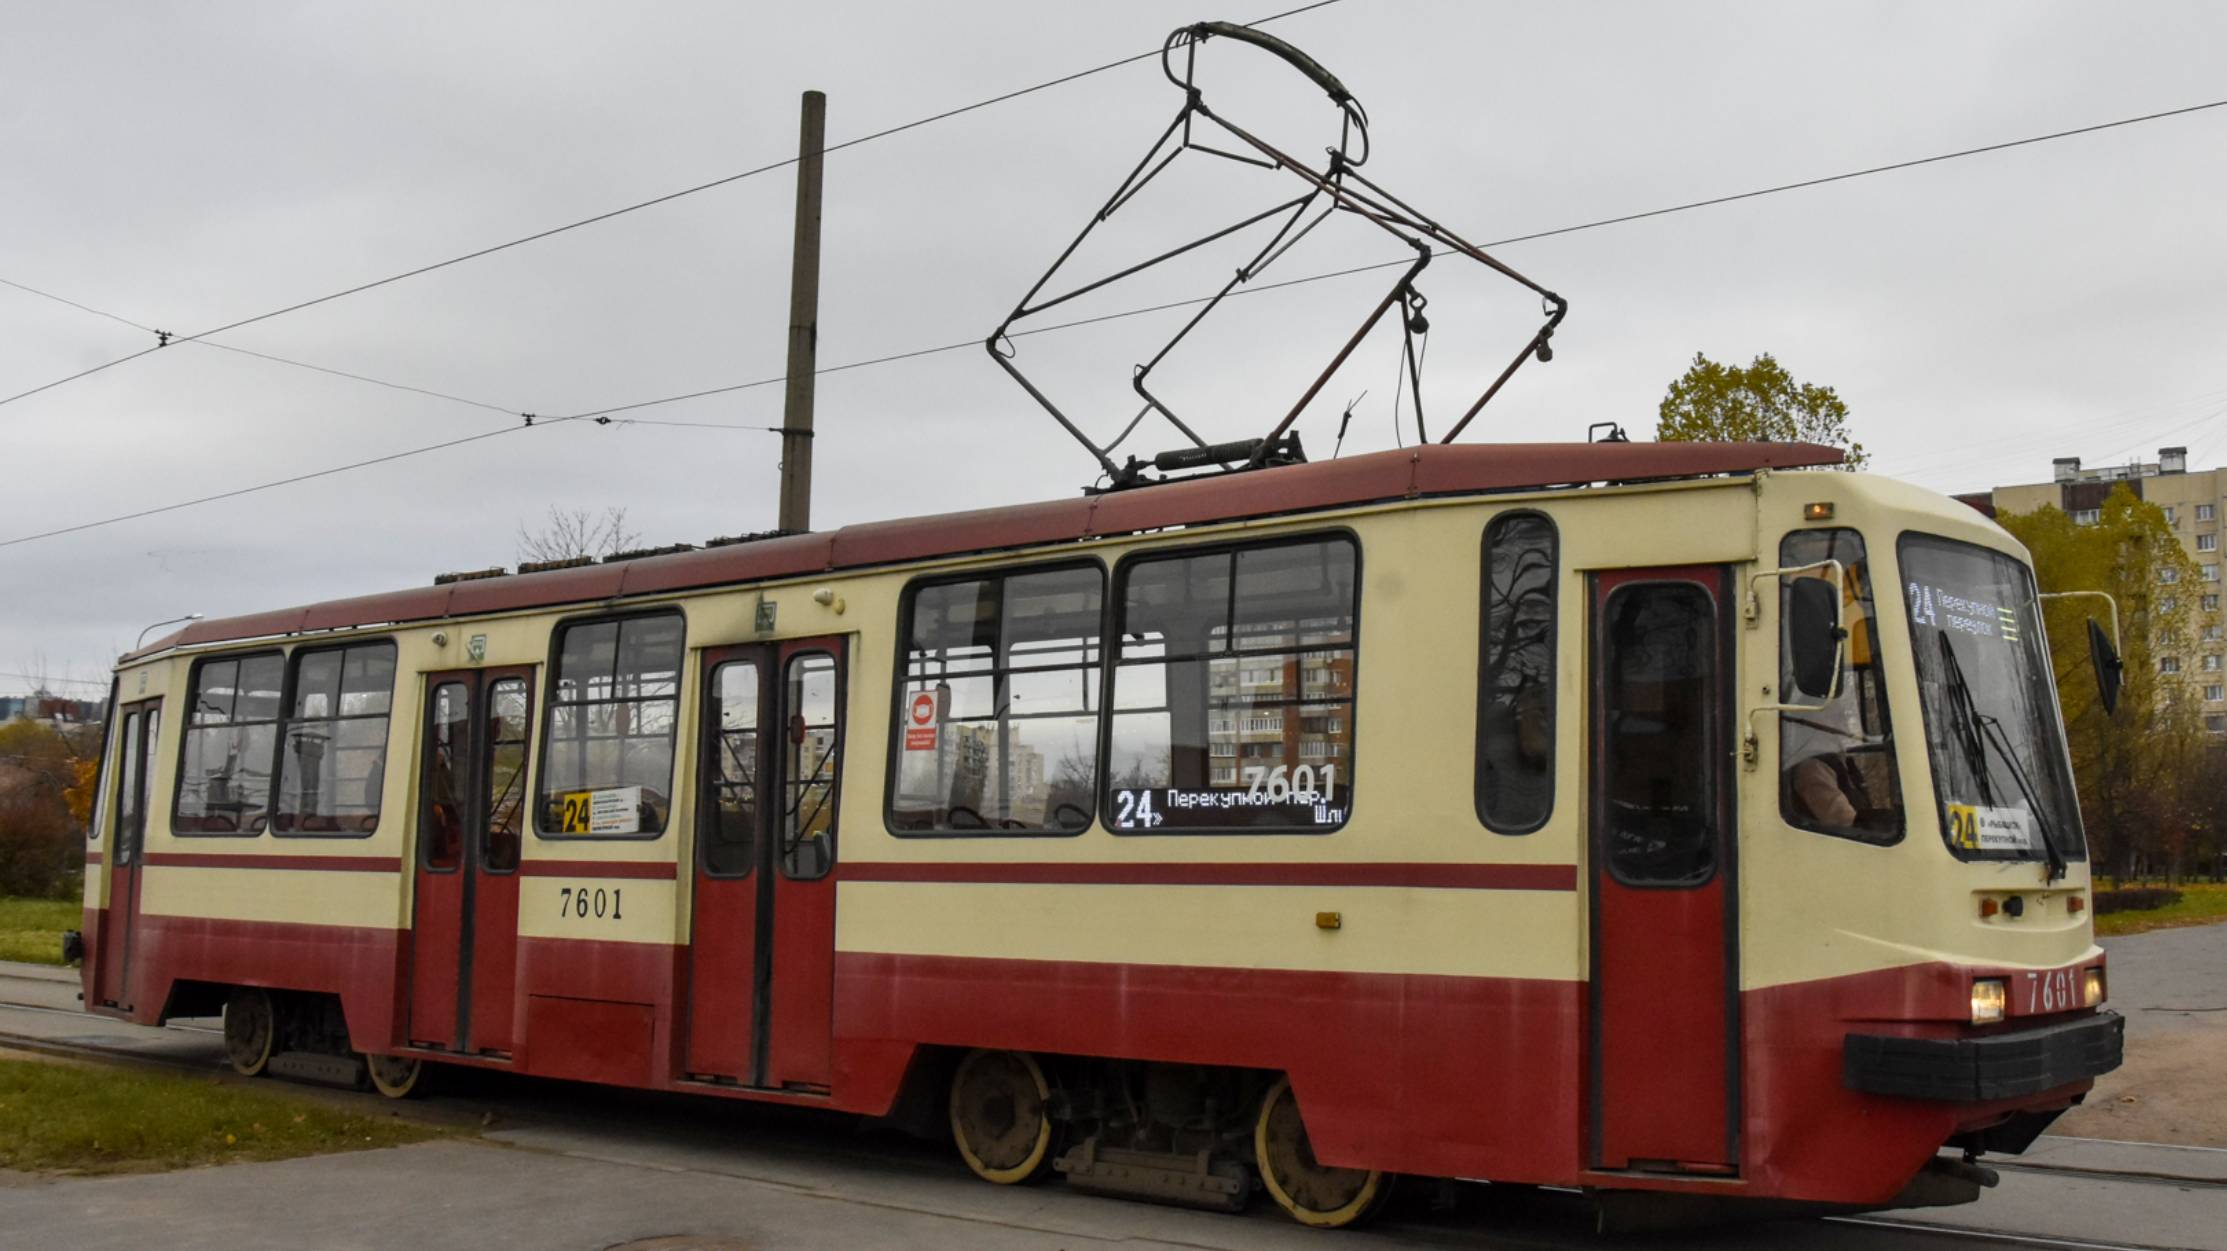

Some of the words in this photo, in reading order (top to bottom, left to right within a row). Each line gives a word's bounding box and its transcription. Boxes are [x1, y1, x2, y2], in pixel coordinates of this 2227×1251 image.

[1909, 582, 1936, 626] 24
[1244, 764, 1335, 801] 7601
[564, 798, 590, 833] 24
[1951, 810, 1979, 849] 24
[560, 888, 622, 920] 7601
[2026, 967, 2077, 1014] 7601
